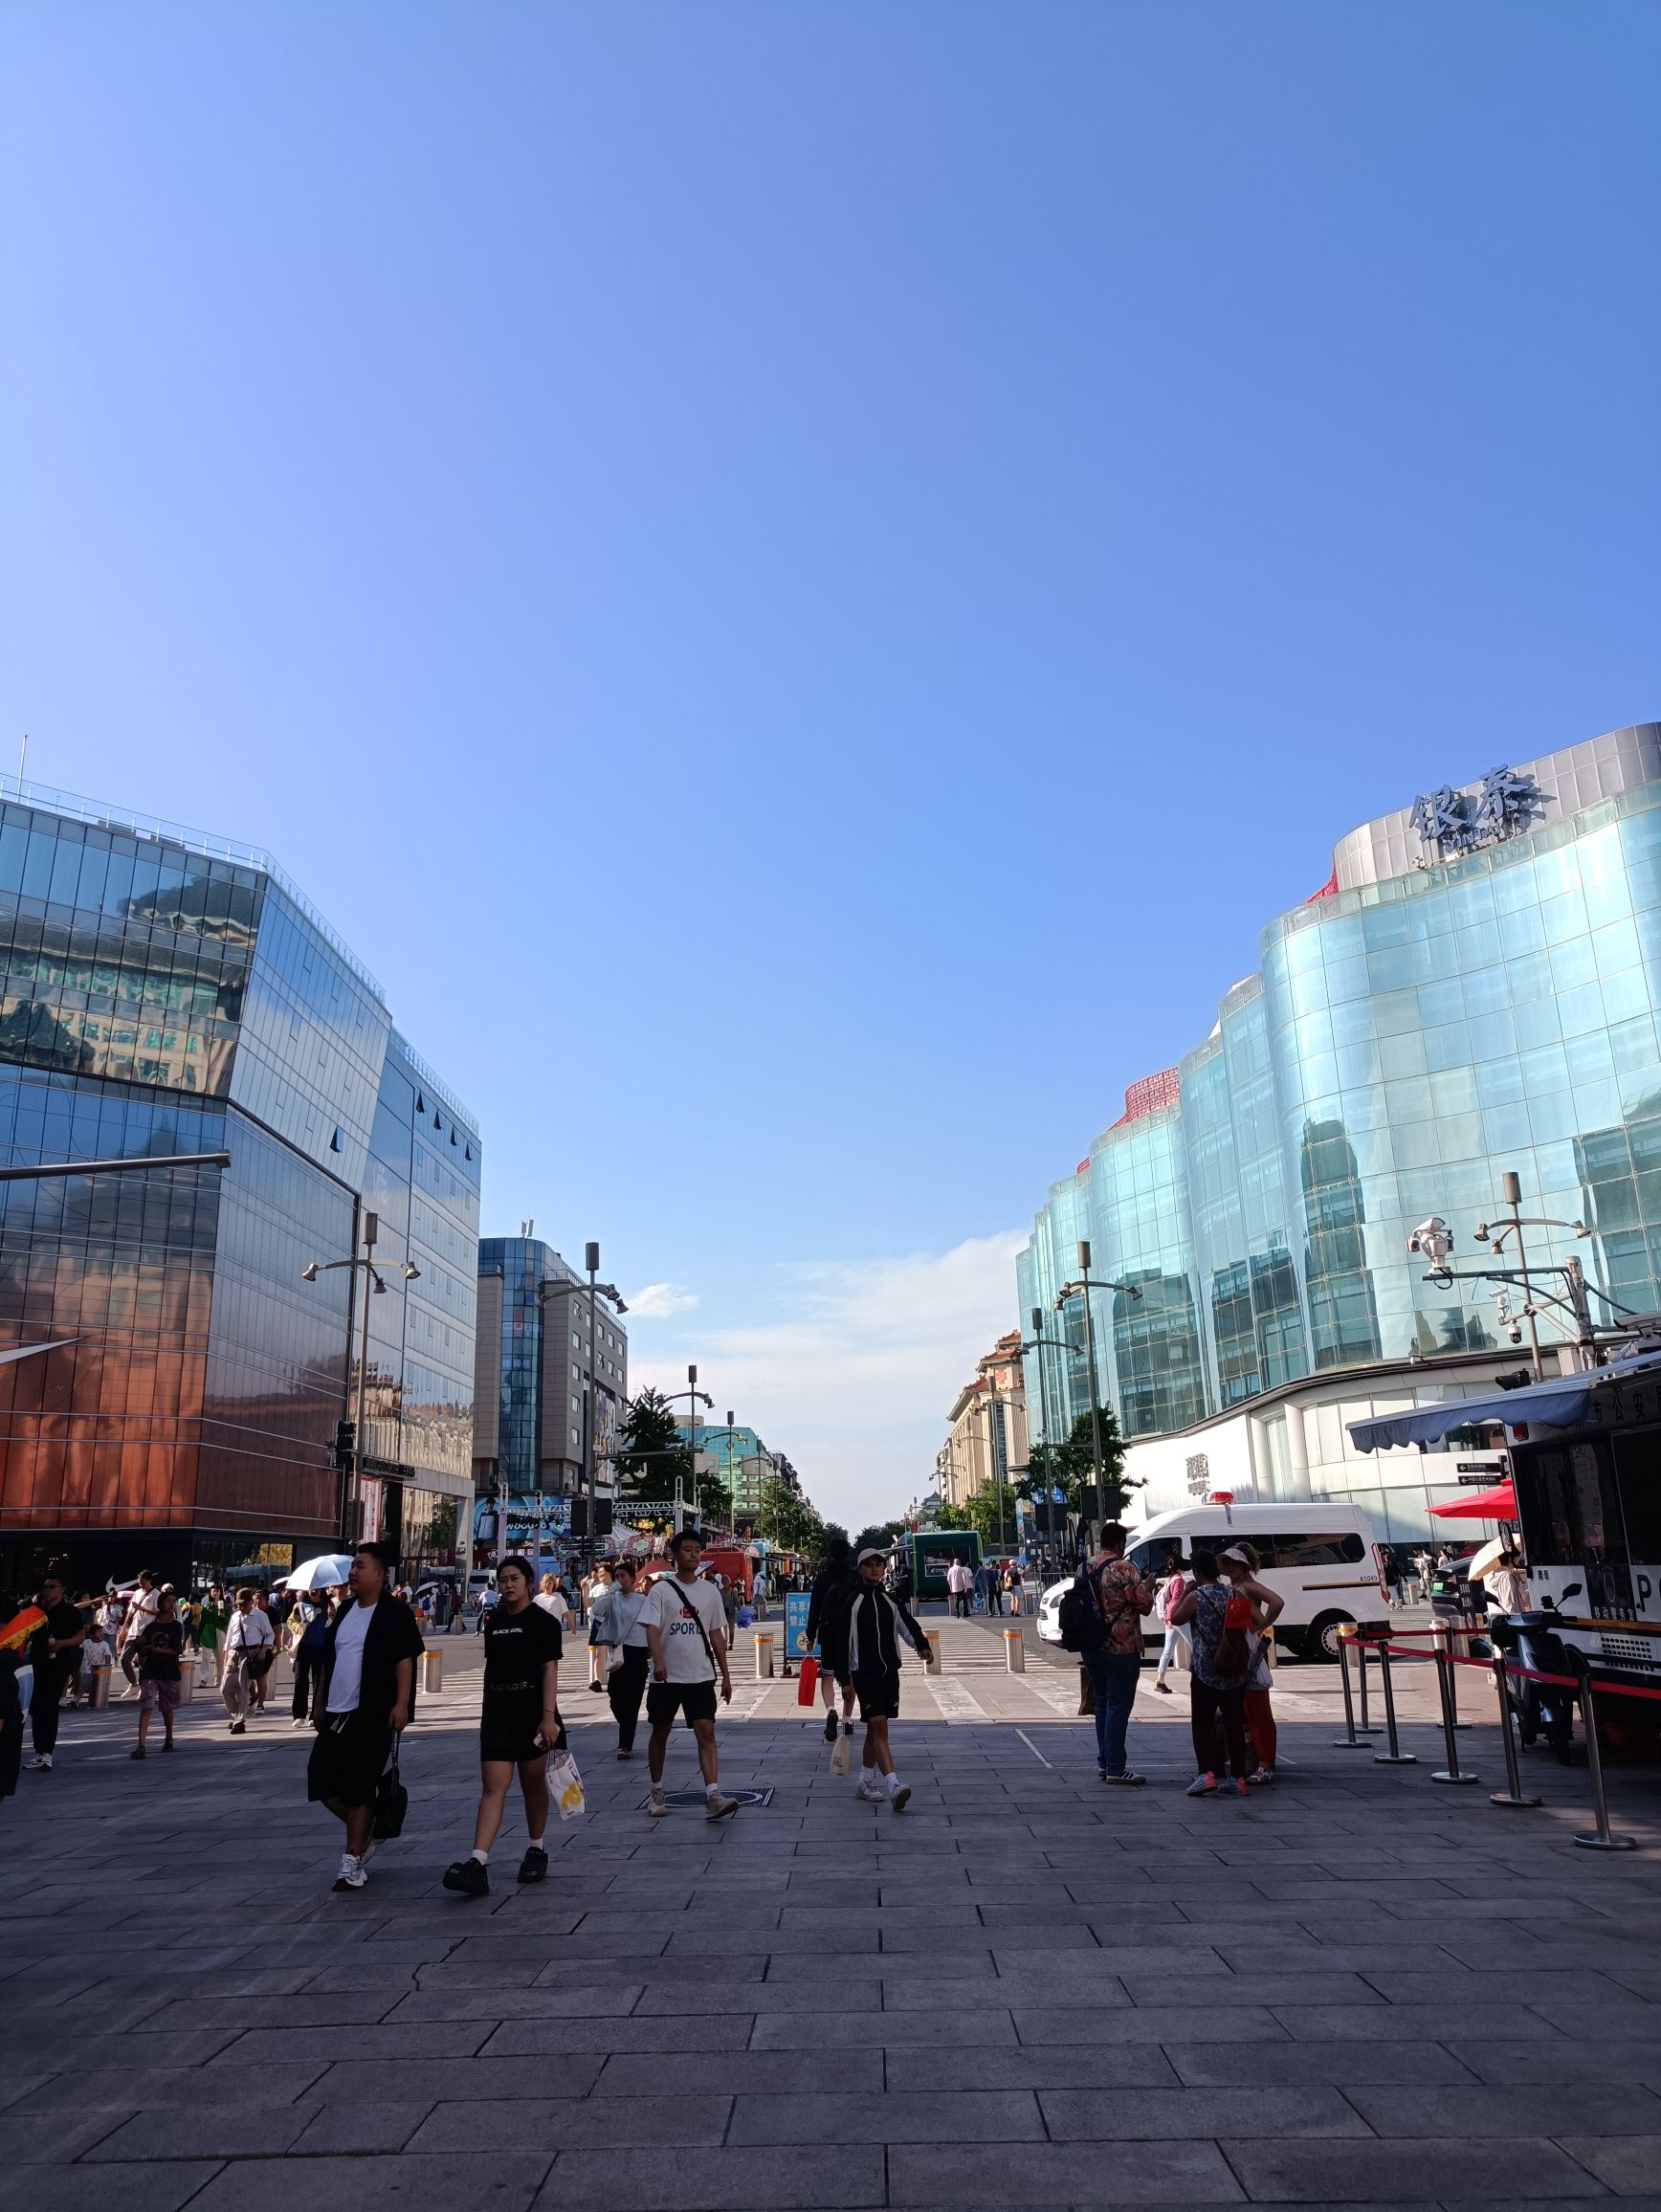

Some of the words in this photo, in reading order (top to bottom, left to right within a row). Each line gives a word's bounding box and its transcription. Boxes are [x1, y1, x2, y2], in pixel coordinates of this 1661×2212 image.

[1409, 763, 1534, 843] 银泰
[1447, 823, 1500, 849] YINTAI
[789, 1615, 808, 1626] 禁止
